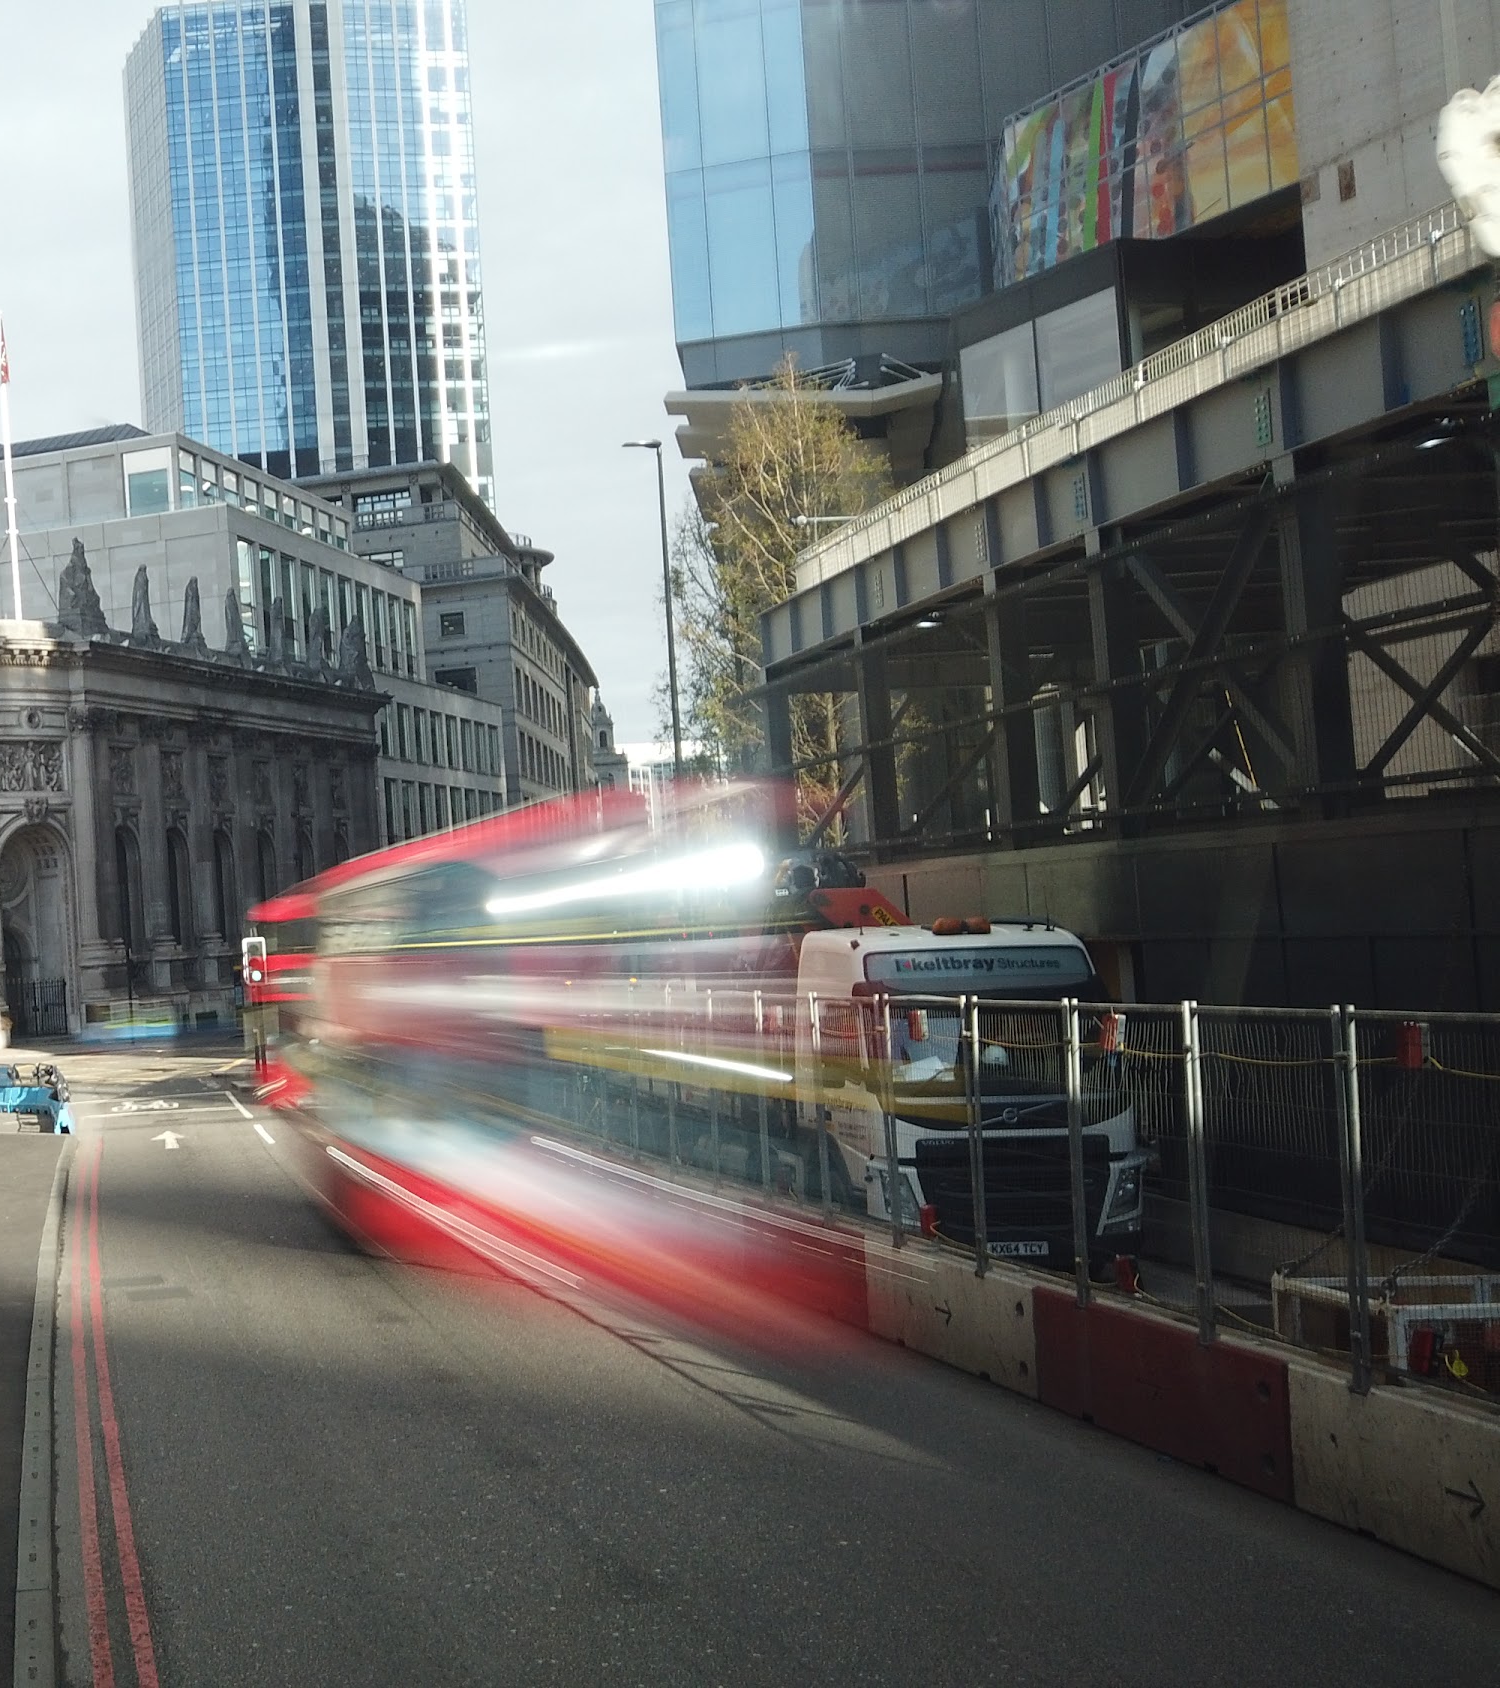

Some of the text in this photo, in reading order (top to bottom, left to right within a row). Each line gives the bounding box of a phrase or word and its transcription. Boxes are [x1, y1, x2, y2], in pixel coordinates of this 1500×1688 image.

[911, 956, 1060, 972] keltbray Structures
[991, 1242, 1044, 1254] KX64 TCY
